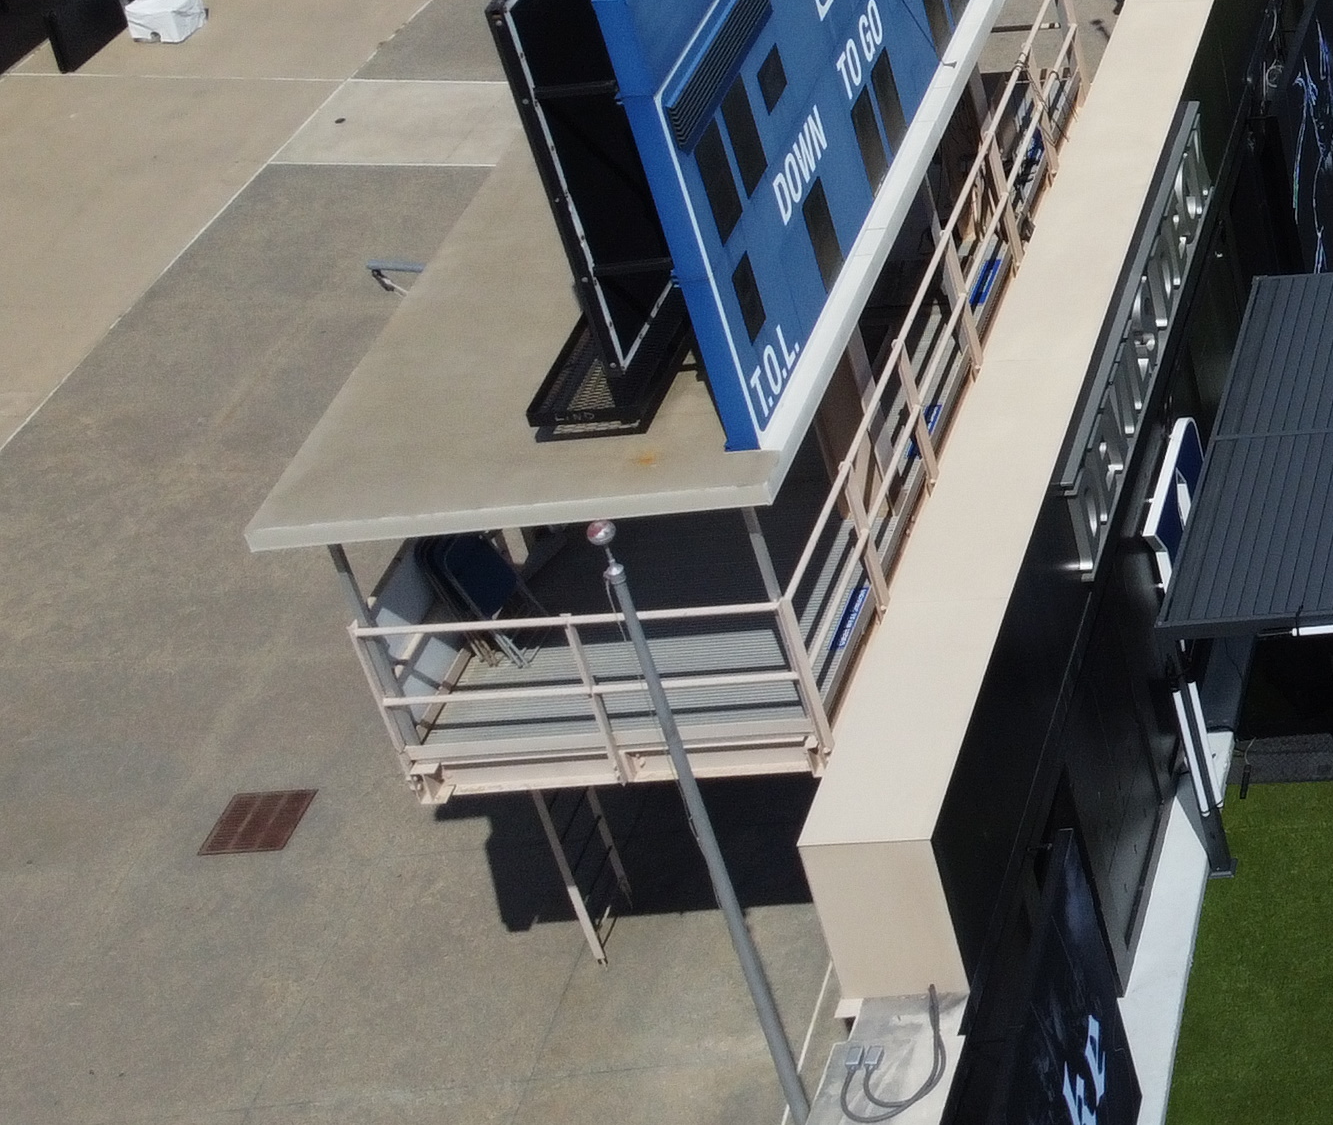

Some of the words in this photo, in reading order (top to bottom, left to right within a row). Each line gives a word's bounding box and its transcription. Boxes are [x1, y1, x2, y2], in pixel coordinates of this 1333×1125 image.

[836, 51, 863, 100] TO
[772, 104, 827, 226] DOWN
[750, 324, 800, 417] T.O.L.
